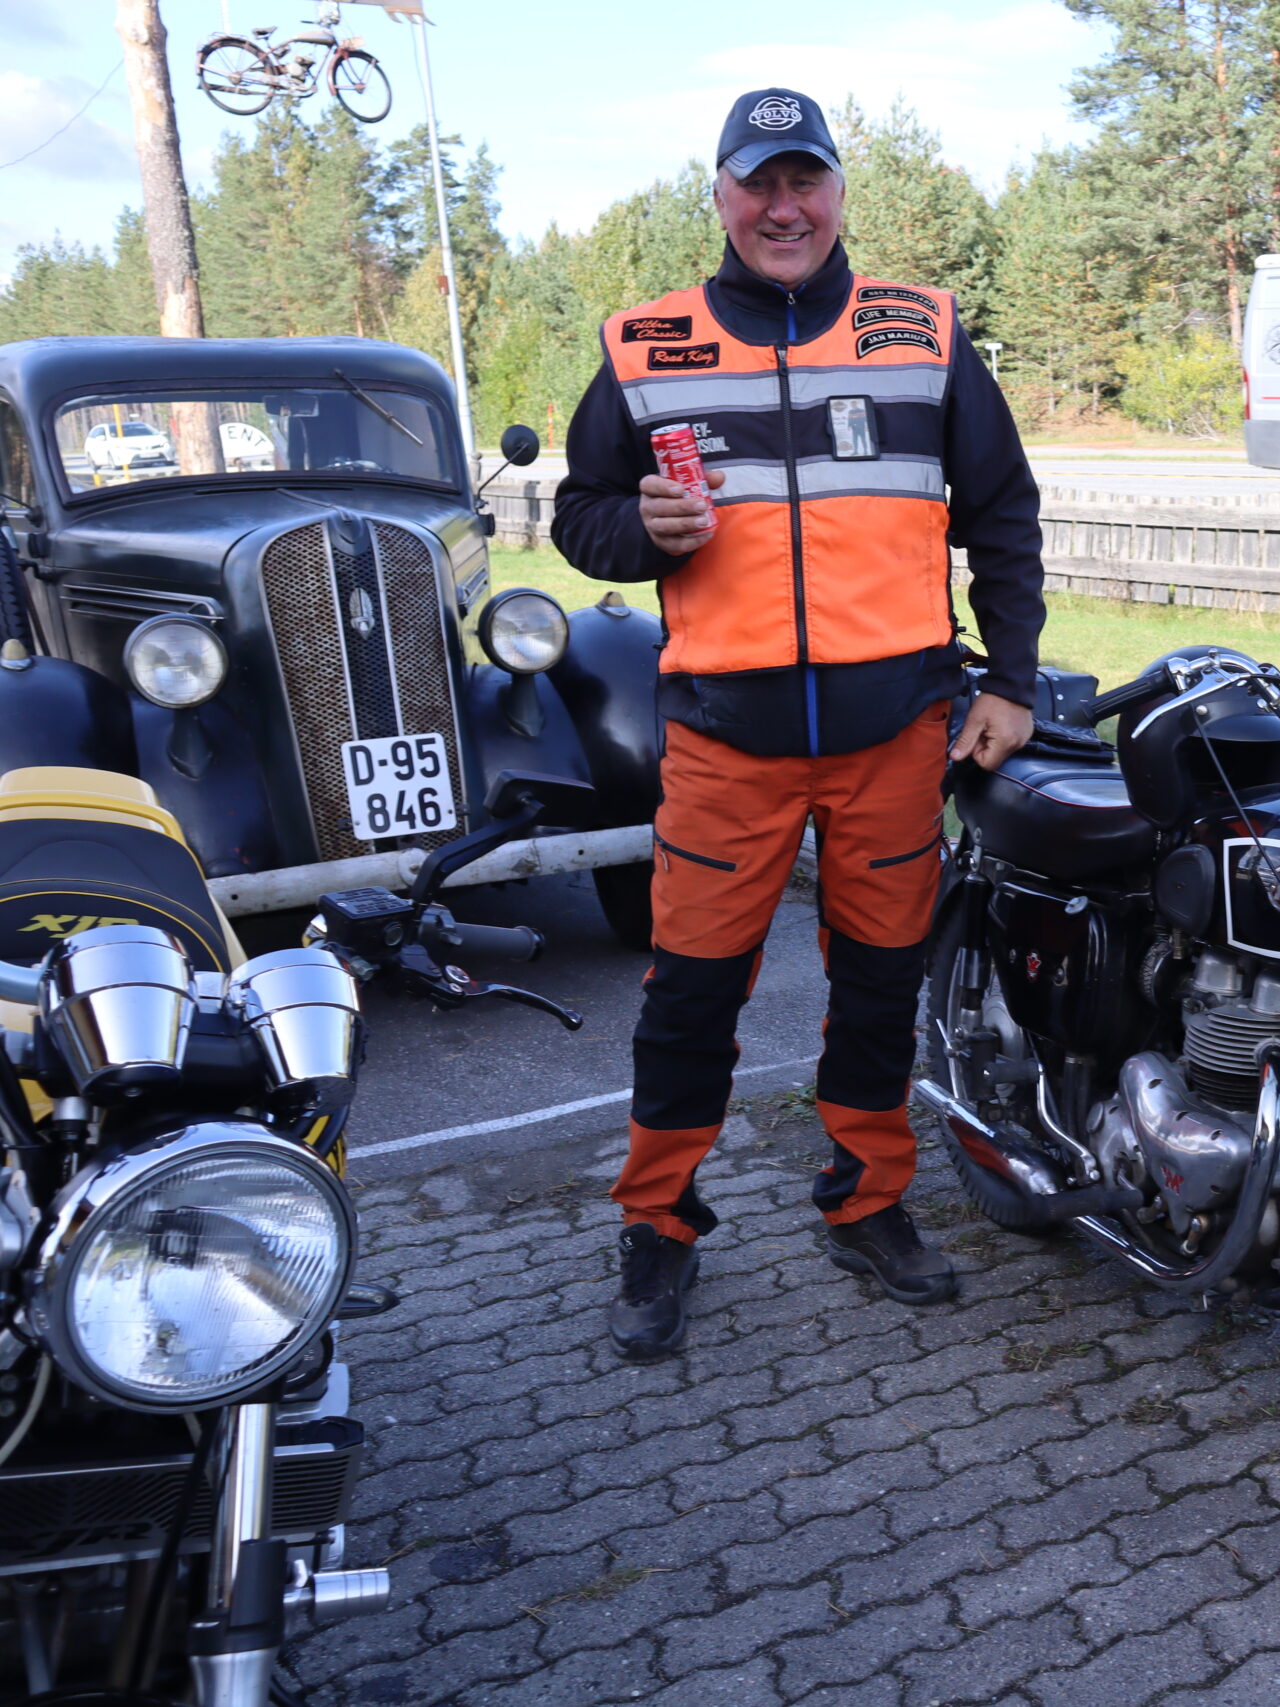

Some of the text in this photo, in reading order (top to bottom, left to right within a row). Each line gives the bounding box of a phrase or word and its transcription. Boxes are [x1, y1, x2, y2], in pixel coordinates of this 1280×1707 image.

[754, 110, 799, 120] VOLVO
[861, 310, 924, 320] LIFE MEMBER
[625, 320, 674, 330] Ultra
[636, 329, 689, 338] Classic
[868, 332, 927, 344] JAN MARIUS
[653, 350, 714, 365] Road King
[349, 738, 440, 786] D-95
[367, 787, 442, 833] 846
